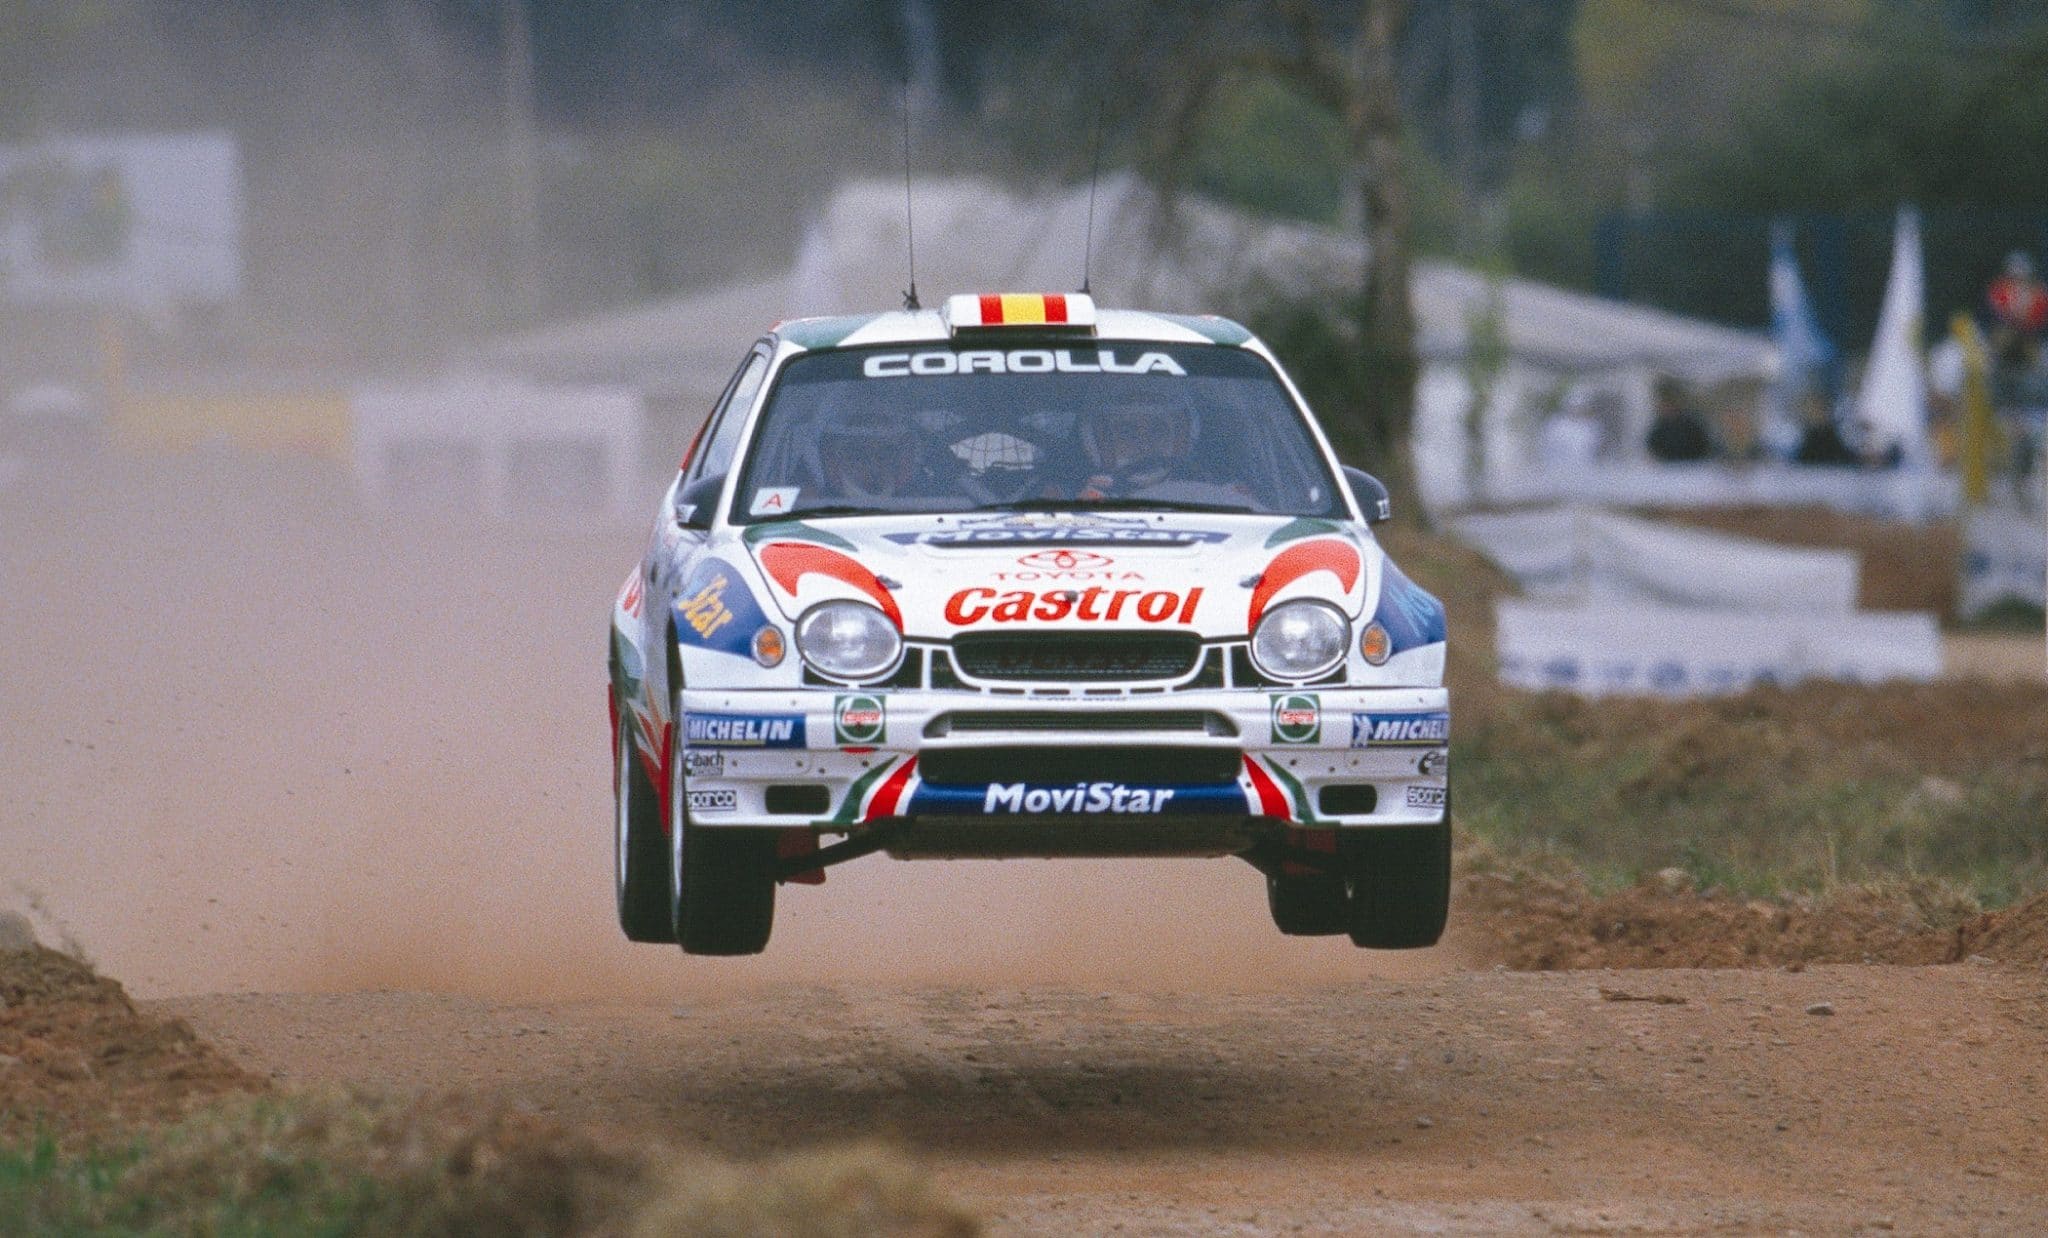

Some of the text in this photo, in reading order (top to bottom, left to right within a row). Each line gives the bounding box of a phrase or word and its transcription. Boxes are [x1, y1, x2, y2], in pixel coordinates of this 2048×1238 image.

[863, 350, 1187, 378] COROLLA
[762, 494, 781, 508] A
[995, 572, 1145, 581] TOYOTA
[944, 586, 1205, 626] Castrol
[688, 719, 794, 740] MICHELIN
[983, 782, 1174, 814] MoviStar
